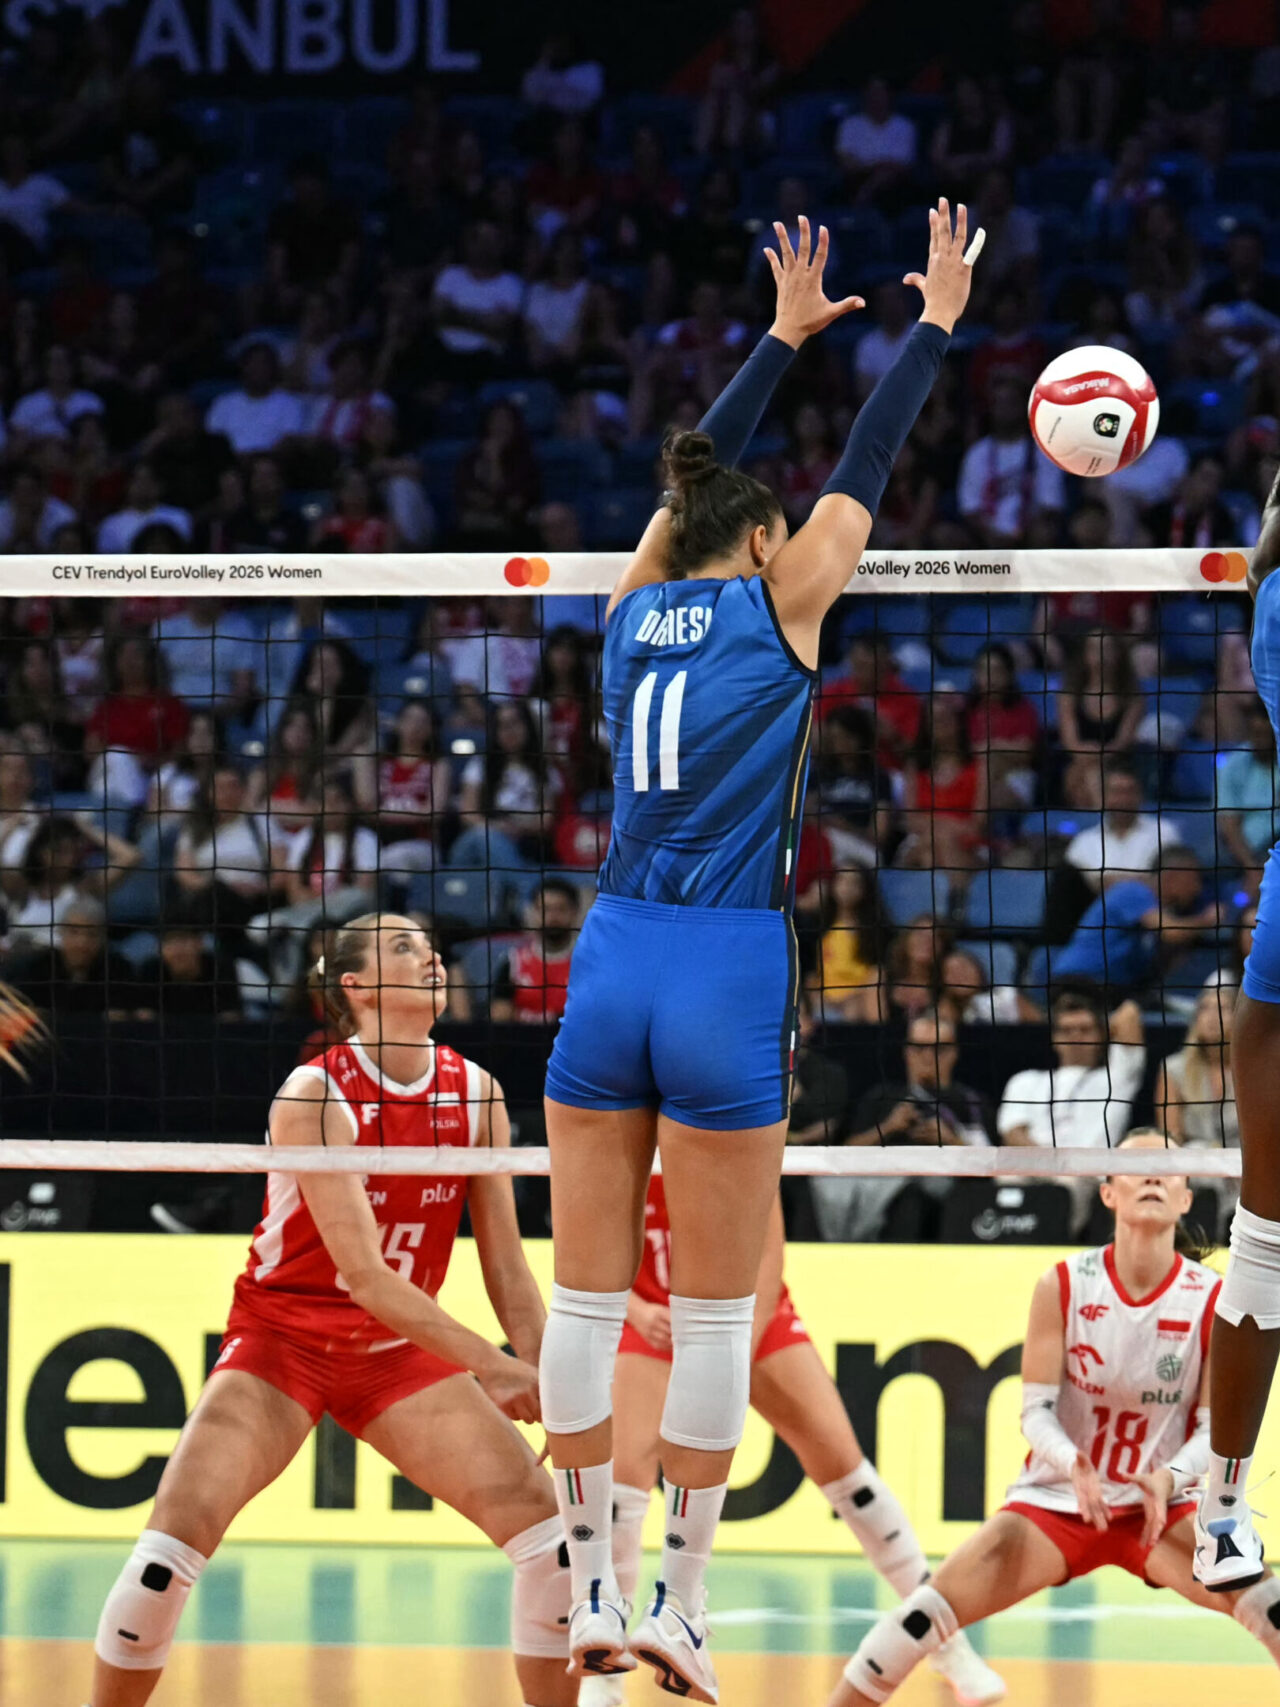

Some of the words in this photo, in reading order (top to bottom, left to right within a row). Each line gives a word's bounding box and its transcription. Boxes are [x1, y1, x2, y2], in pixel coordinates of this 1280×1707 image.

[52, 565, 82, 580] CEV
[85, 565, 147, 582] Trendyol
[150, 565, 225, 582] EuroVolley
[229, 565, 264, 579] 2026
[267, 565, 322, 579] Women
[914, 561, 950, 575] 2026
[954, 561, 1011, 575] Women
[632, 671, 687, 792] 11
[1090, 1405, 1149, 1485] 18
